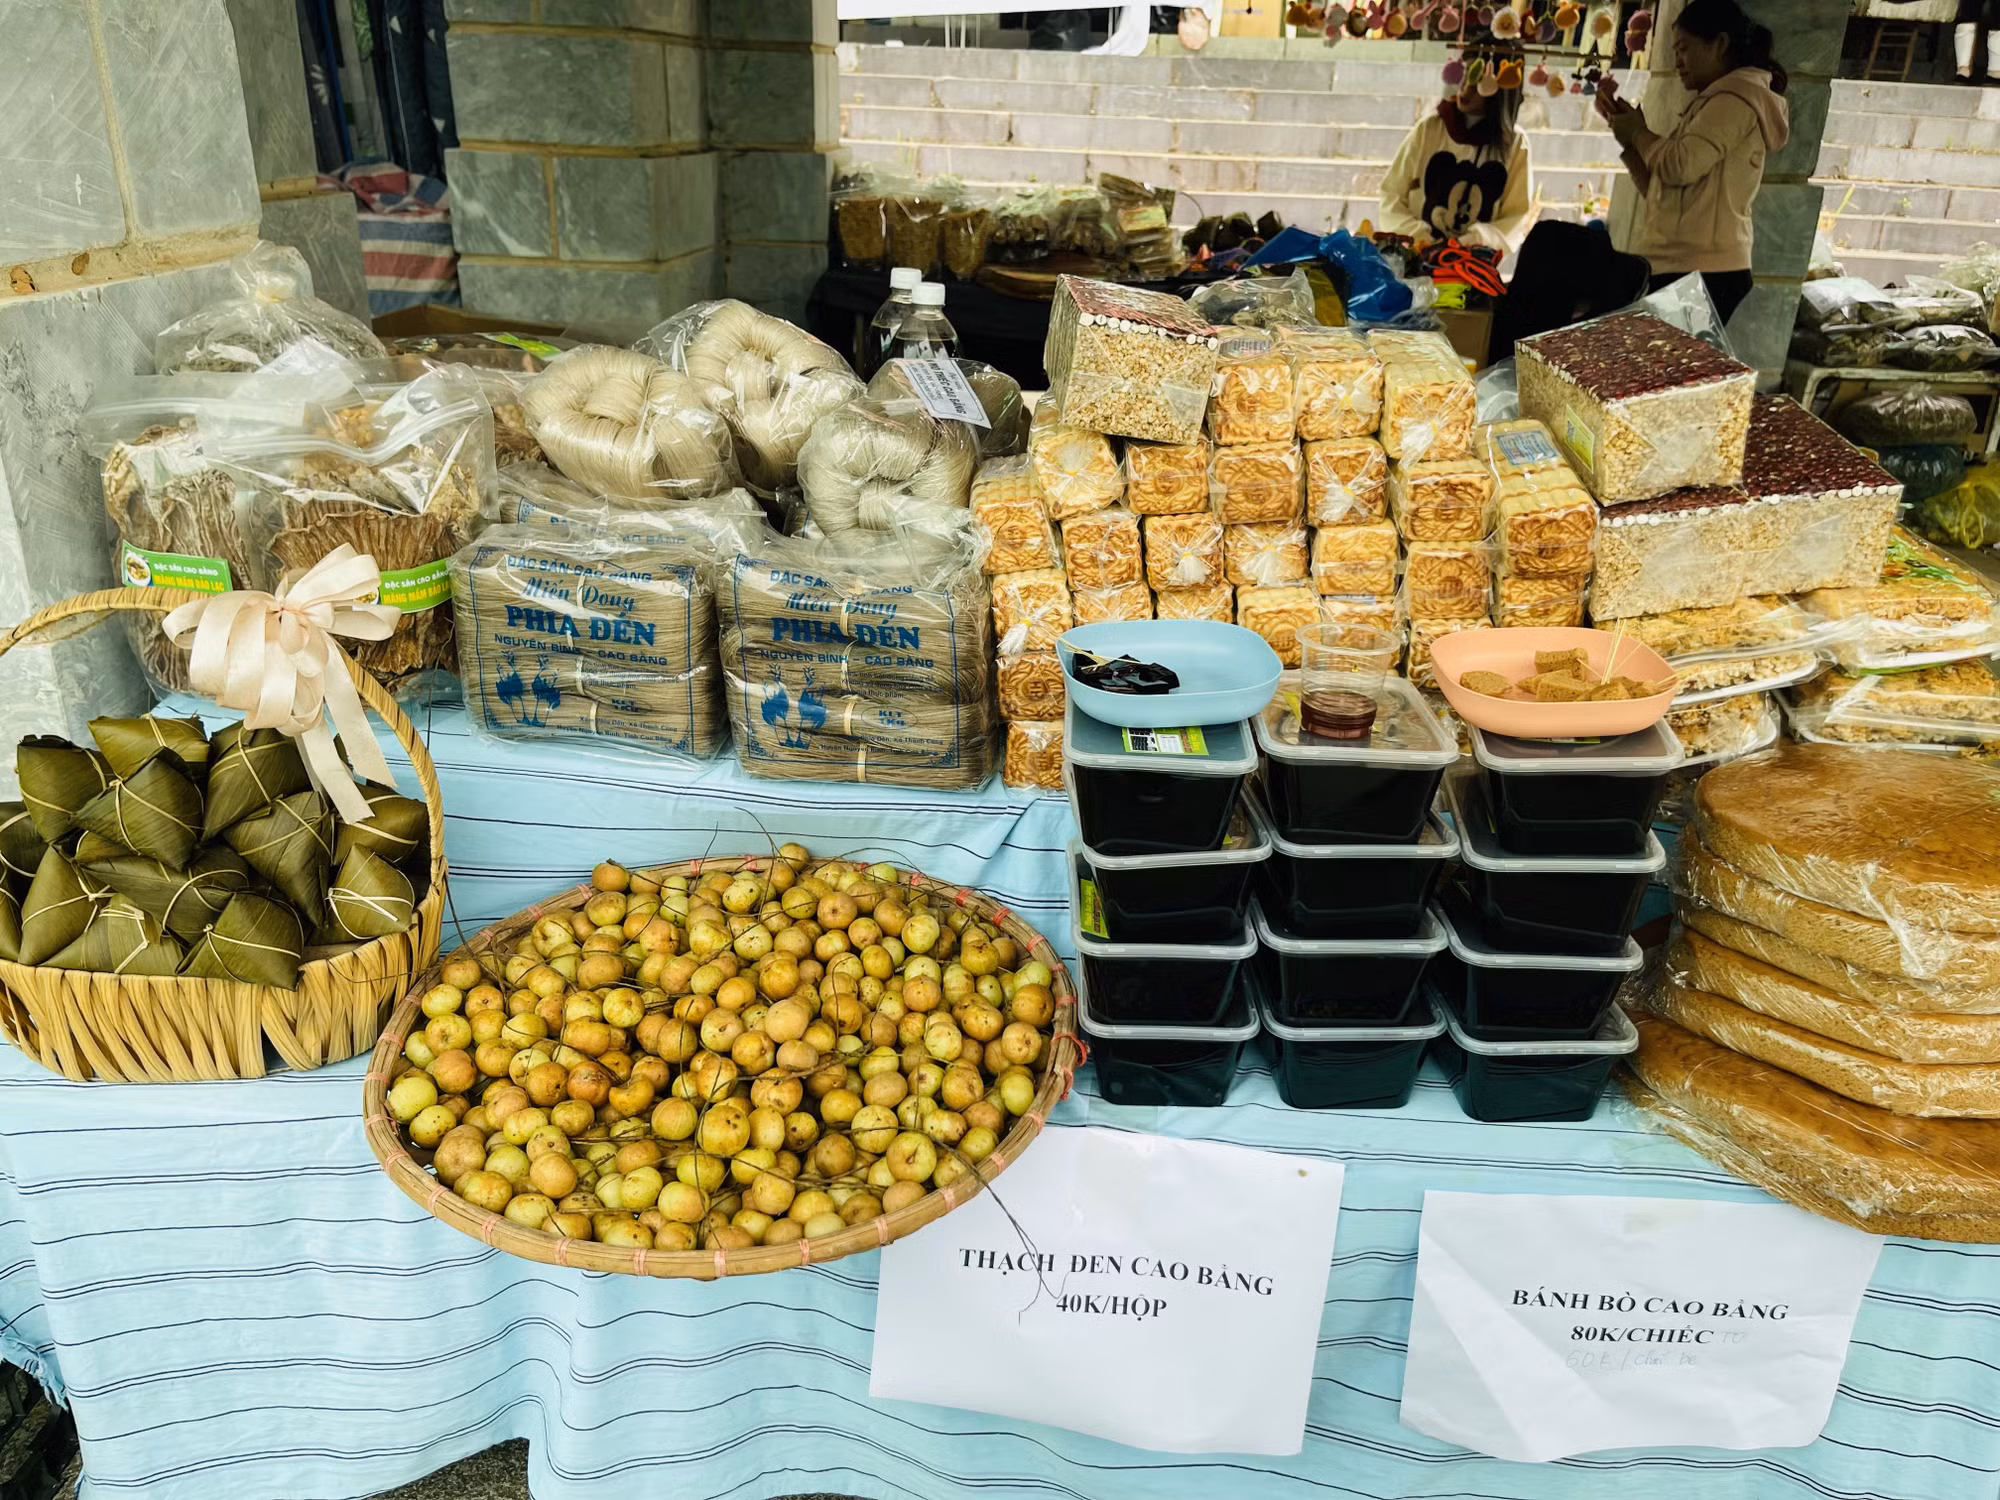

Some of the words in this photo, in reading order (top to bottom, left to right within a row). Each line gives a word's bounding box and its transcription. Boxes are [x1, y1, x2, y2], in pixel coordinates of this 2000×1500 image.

[384, 581, 400, 590] ĐẶC
[401, 578, 416, 588] SẢN
[416, 575, 431, 585] CAO
[770, 569, 801, 585] ĐẶC
[520, 576, 570, 601] Miến
[578, 583, 636, 612] Dong
[785, 591, 831, 613] Miến
[844, 601, 898, 620] Dong
[504, 605, 581, 638] PHIA
[771, 617, 853, 645] PHIA
[494, 633, 547, 651] NGUYÊN
[598, 649, 626, 661] CAO
[630, 651, 668, 666] BẰNG
[818, 653, 849, 664] BÌNH
[865, 656, 893, 666] CAO
[896, 654, 935, 668] BẰNG
[959, 1248, 1056, 1276] THẠCH
[1069, 1254, 1123, 1275] ĐEN
[1131, 1256, 1189, 1282] CAO
[1196, 1263, 1274, 1296] BẰNG
[1056, 1292, 1167, 1322] 40K/HỘP
[1512, 1286, 1590, 1310] BÁNH
[1597, 1291, 1637, 1313] BÒ
[1643, 1297, 1704, 1316] CAO
[1711, 1298, 1789, 1321] BẰNG
[1570, 1324, 1715, 1344] 80K/CHIẾC
